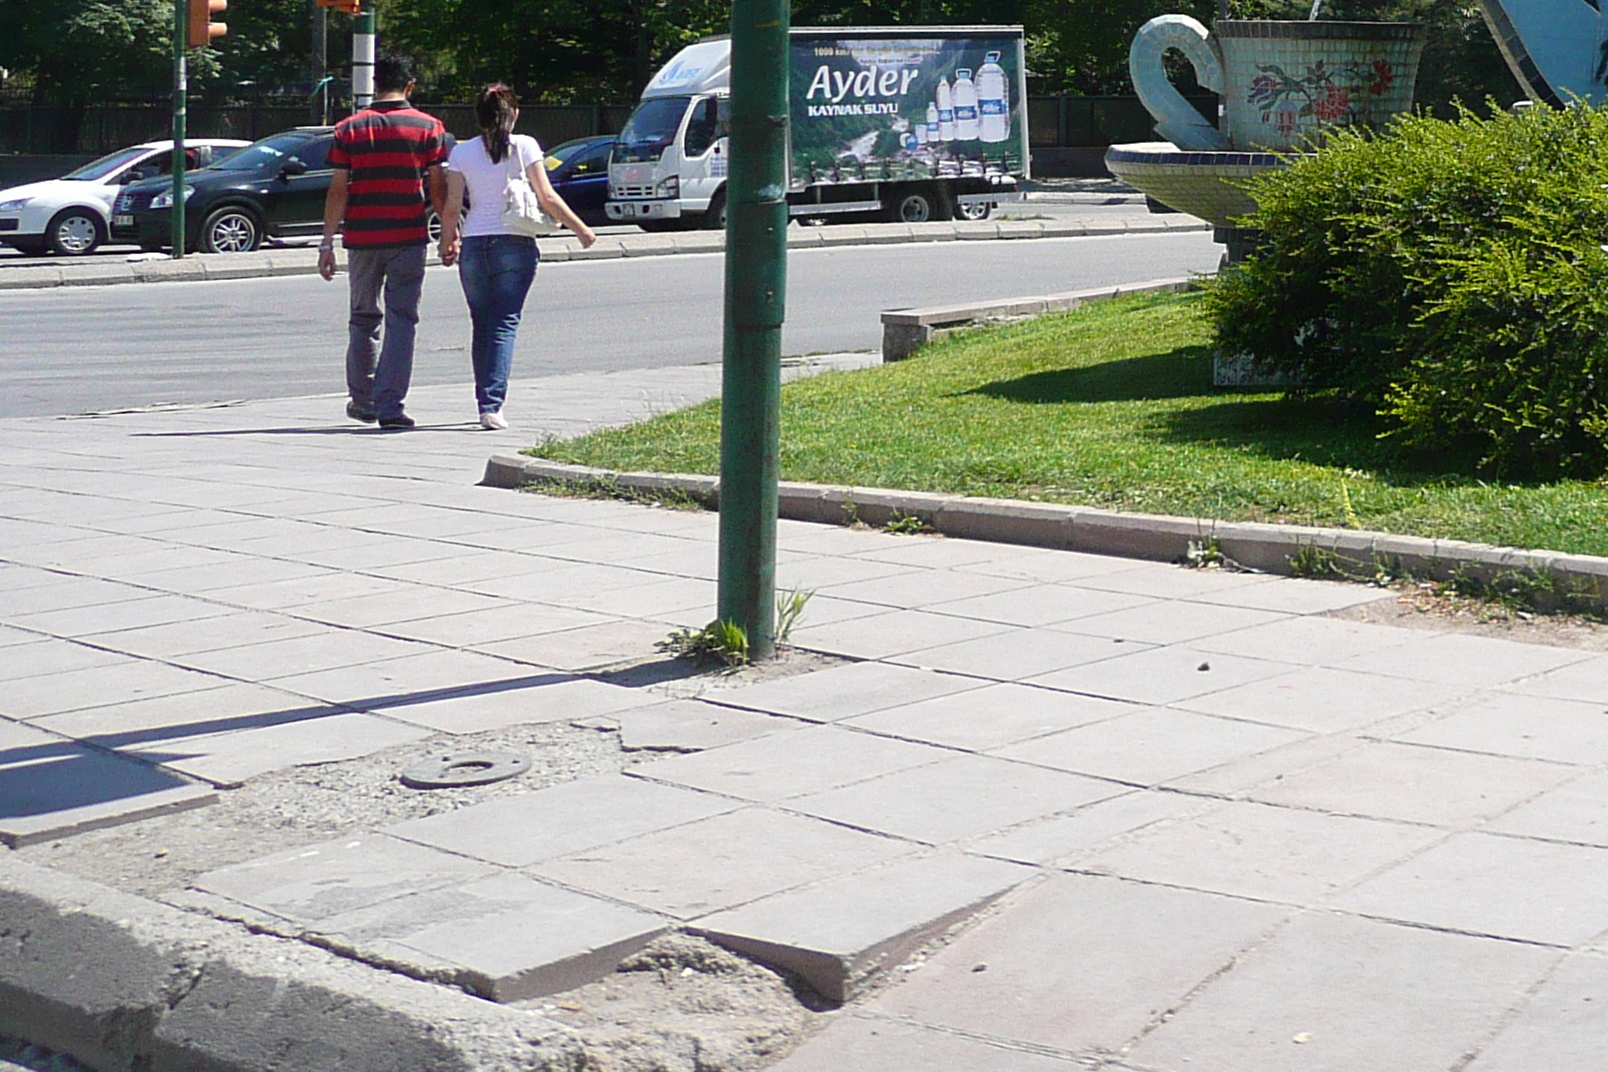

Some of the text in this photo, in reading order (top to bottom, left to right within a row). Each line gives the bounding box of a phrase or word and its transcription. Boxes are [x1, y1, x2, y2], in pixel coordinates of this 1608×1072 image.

[806, 65, 919, 103] Ayder
[808, 103, 899, 117] KAYNAK SUYU
